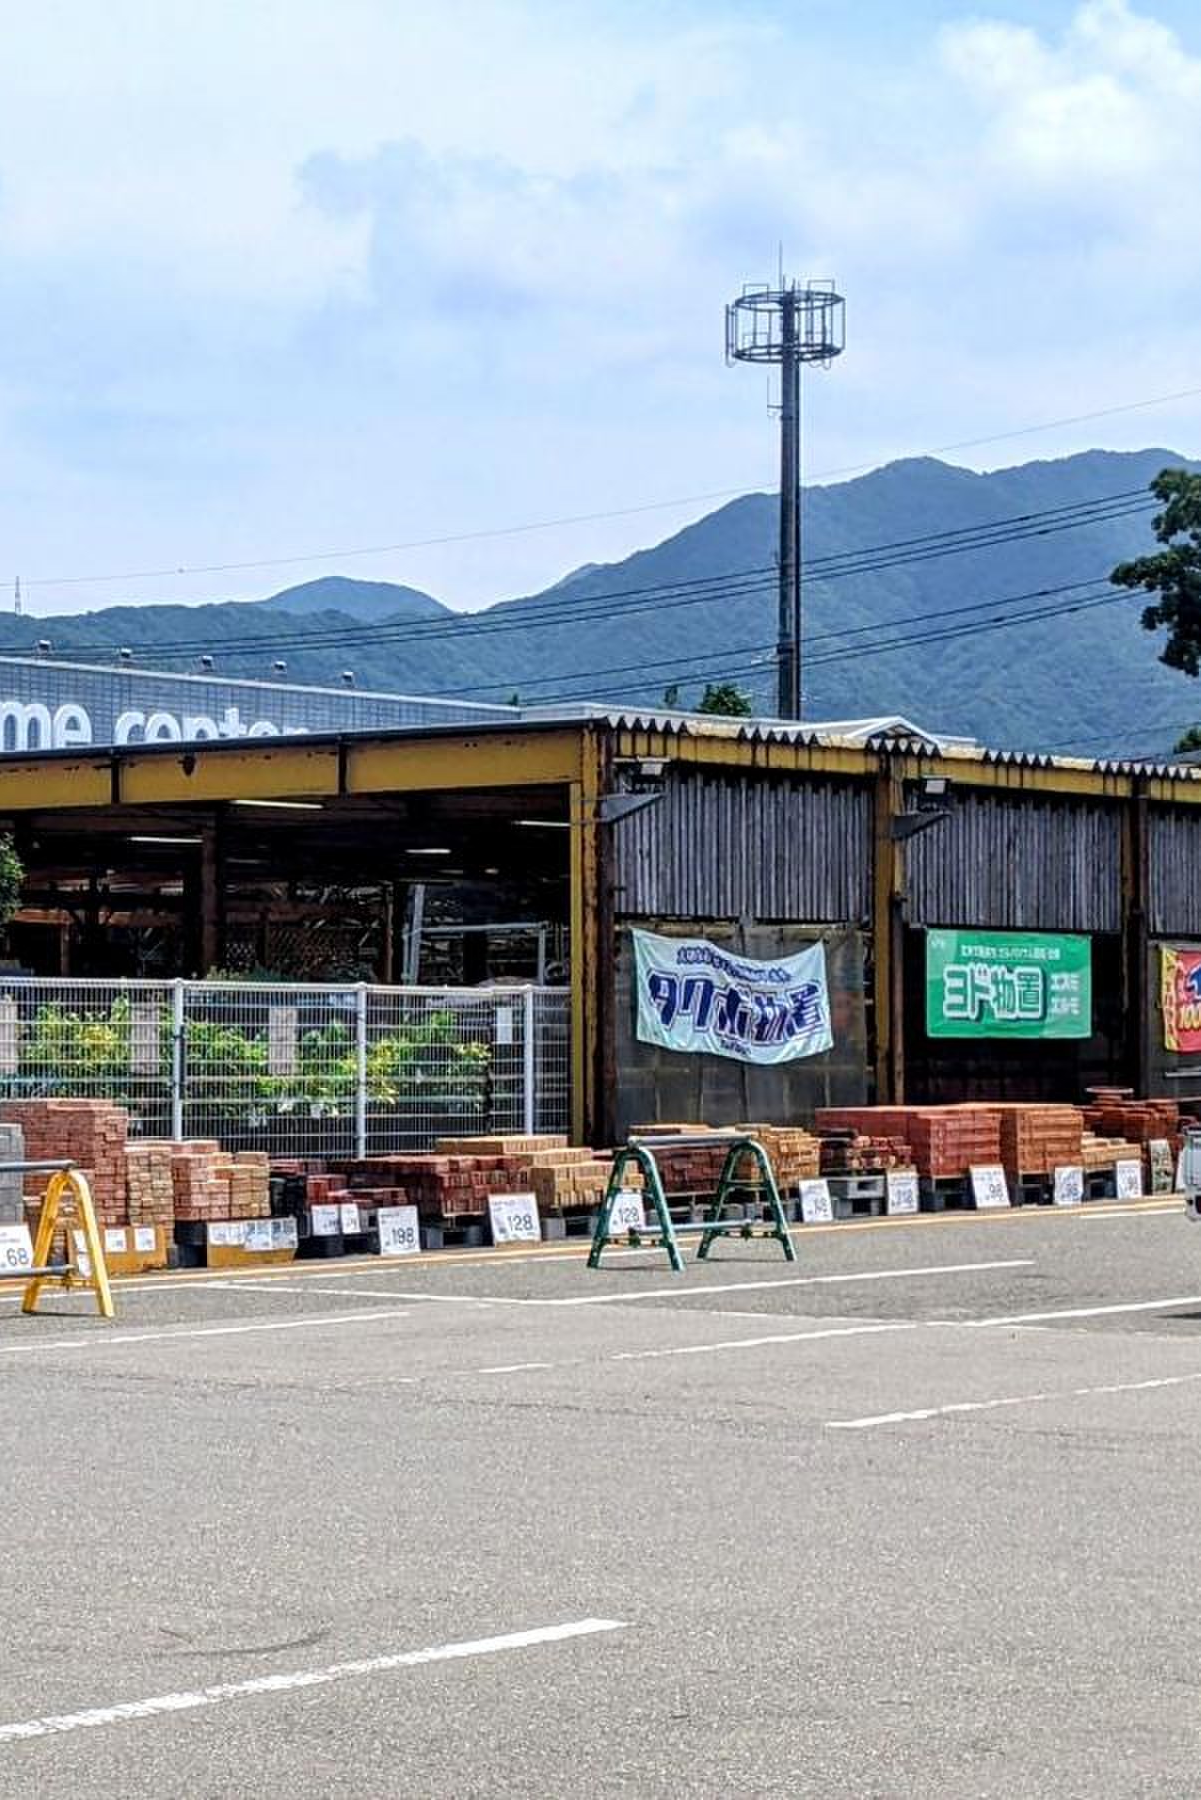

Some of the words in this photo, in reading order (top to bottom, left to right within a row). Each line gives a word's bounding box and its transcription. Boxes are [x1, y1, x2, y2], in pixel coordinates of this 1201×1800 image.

[507, 1214, 534, 1232] 128
[391, 1226, 415, 1245] 198
[6, 1247, 30, 1267] 68
